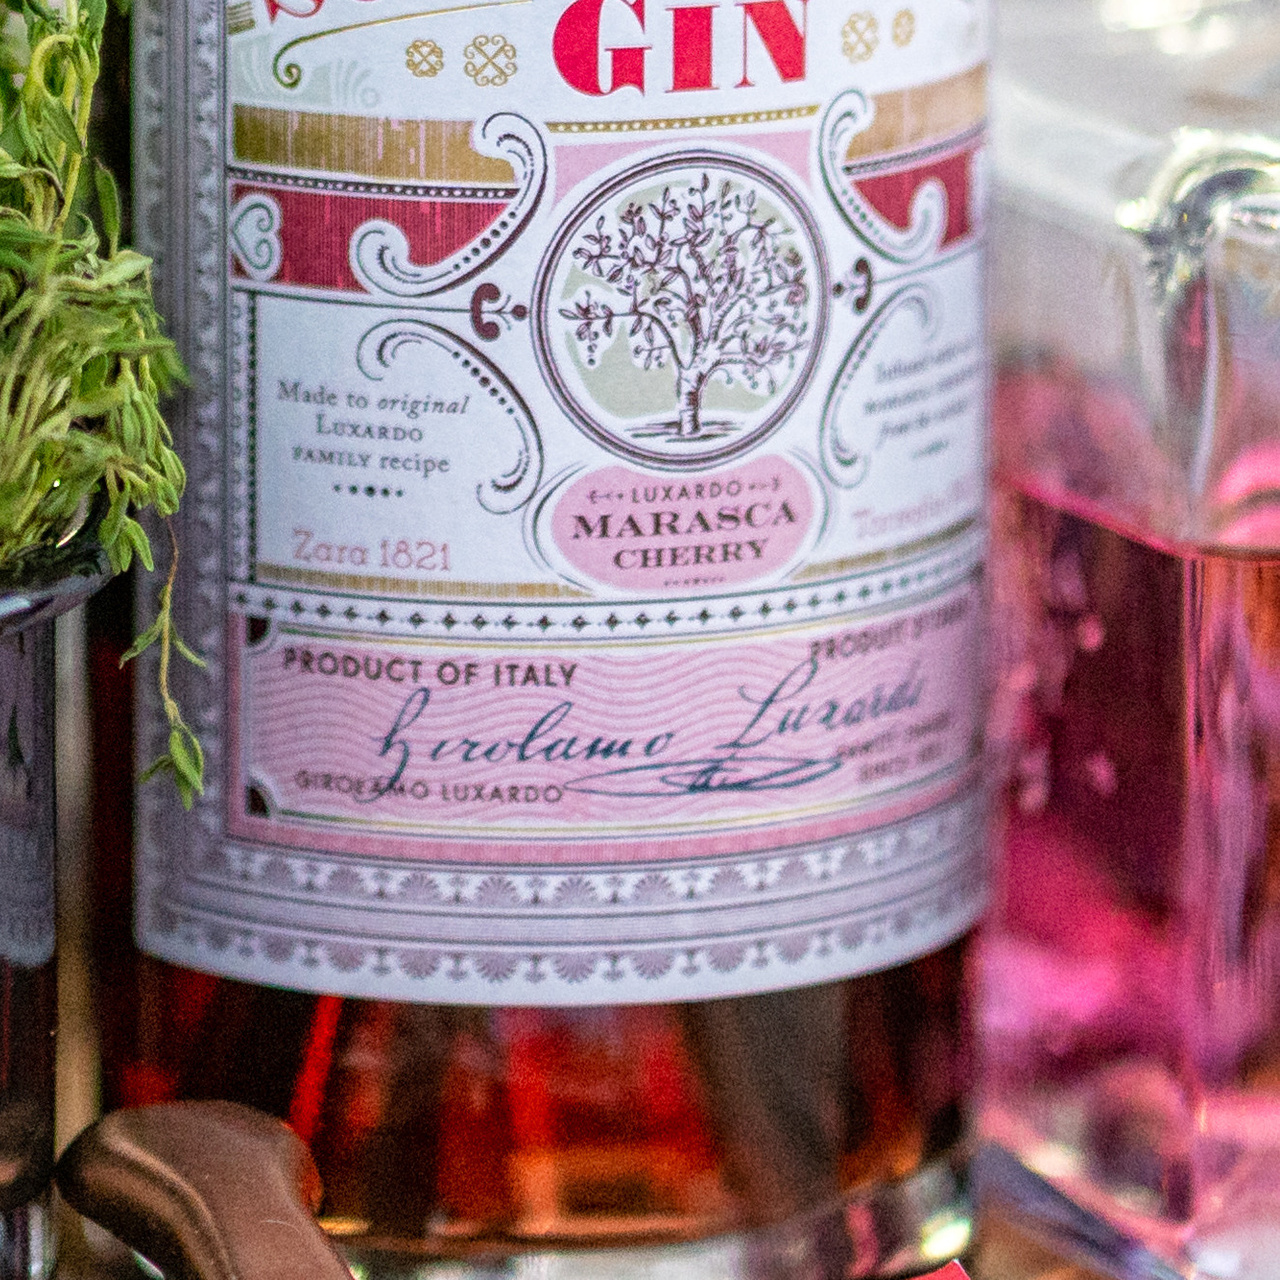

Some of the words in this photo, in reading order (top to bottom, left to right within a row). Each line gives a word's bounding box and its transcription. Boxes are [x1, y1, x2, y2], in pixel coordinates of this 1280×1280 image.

[277, 379, 338, 406] Made
[346, 391, 368, 409] to
[377, 395, 470, 419] original
[291, 445, 372, 468] FAMILY
[379, 453, 451, 478] recipe
[631, 479, 743, 504] LUXARDO
[573, 499, 797, 540] MARASCA
[292, 527, 368, 566] Zara
[380, 539, 452, 572] 1821
[612, 538, 768, 569] CHERRY
[283, 647, 423, 684] PRODUCT
[436, 660, 479, 685] OF
[493, 662, 577, 687] ITALY
[441, 782, 564, 803] LUXARDO
